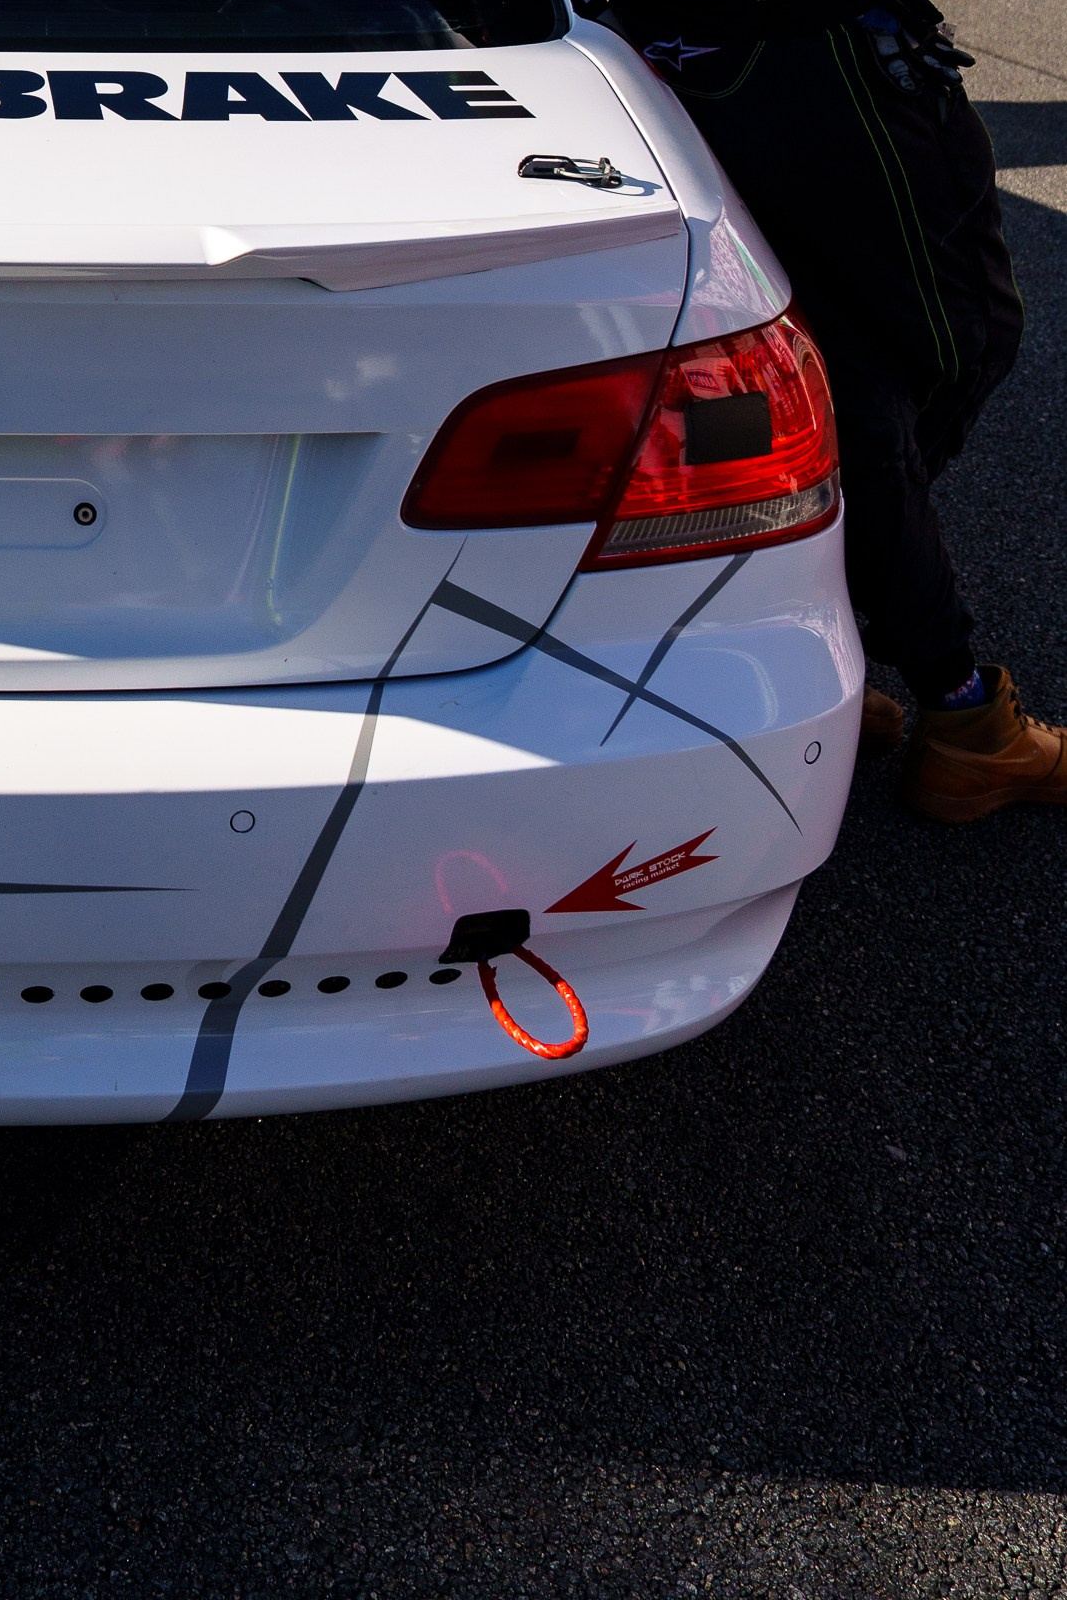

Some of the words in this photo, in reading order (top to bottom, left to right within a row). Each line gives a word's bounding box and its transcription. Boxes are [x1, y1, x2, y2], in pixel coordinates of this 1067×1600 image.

[614, 868, 644, 887] DARK
[648, 851, 687, 873] STOCK
[622, 875, 649, 890] racing
[650, 861, 681, 879] market
